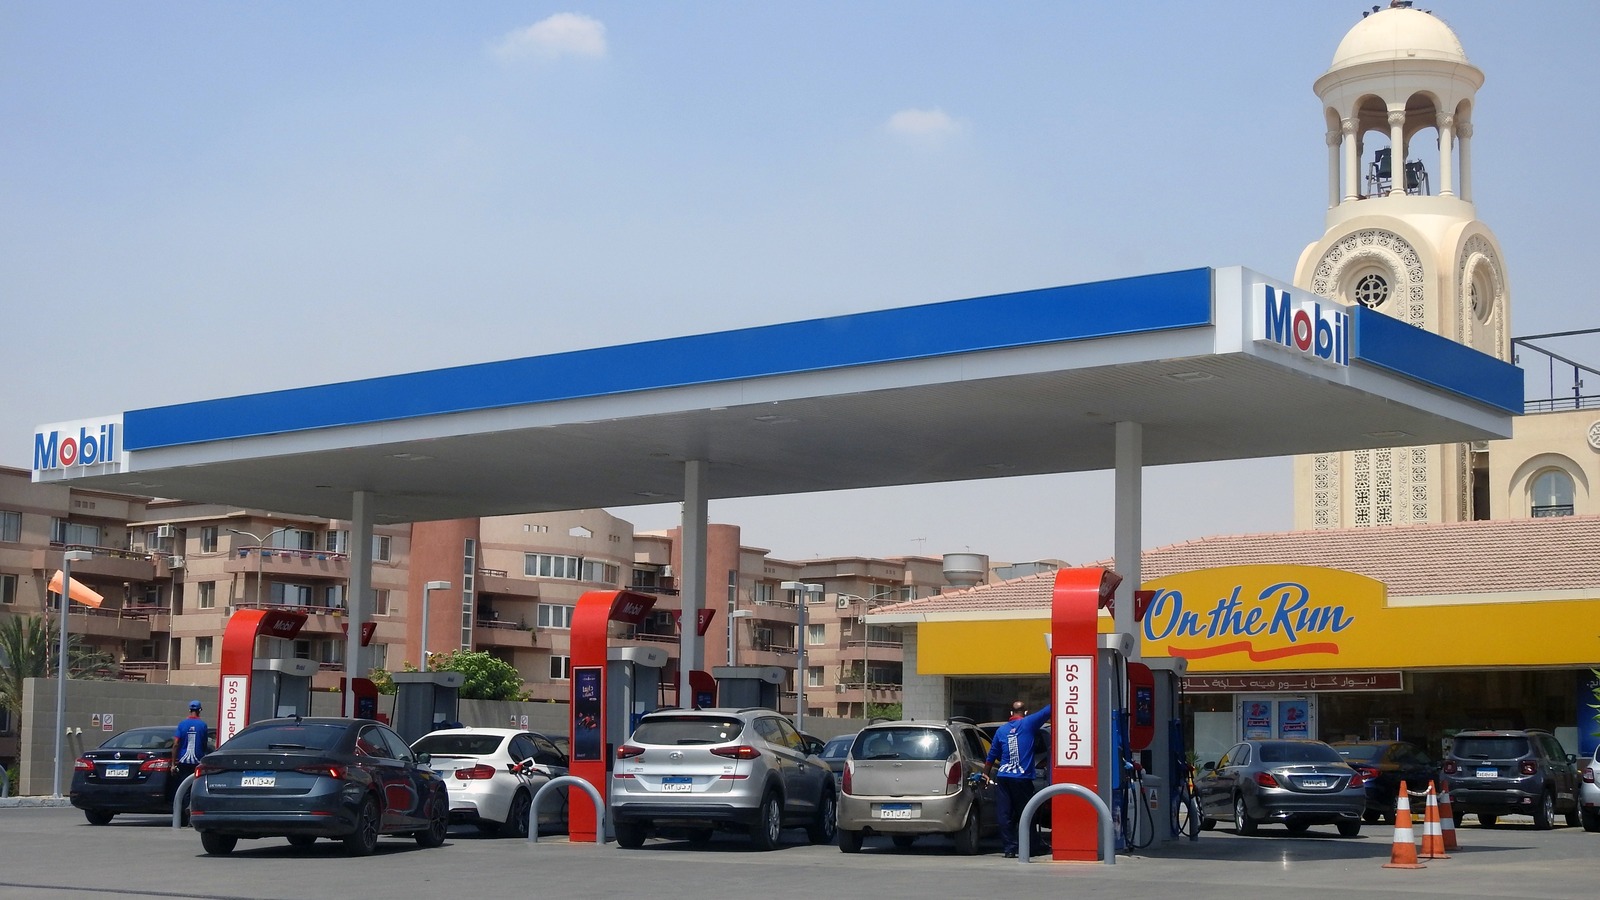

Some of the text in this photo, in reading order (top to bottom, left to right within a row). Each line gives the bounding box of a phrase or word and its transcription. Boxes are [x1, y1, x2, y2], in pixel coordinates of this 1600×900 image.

[1264, 284, 1349, 366] Mobil
[34, 423, 114, 470] Mobil
[623, 602, 643, 615] Mobil
[1136, 598, 1142, 608] 1
[1144, 582, 1354, 643] On the Run
[273, 620, 295, 632] Mobil
[699, 615, 704, 624] 3
[362, 628, 367, 636] 5
[228, 680, 238, 694] 95
[1278, 680, 1308, 690] يوم
[227, 697, 237, 719] Plus
[1065, 664, 1081, 760] Super Plus 95
